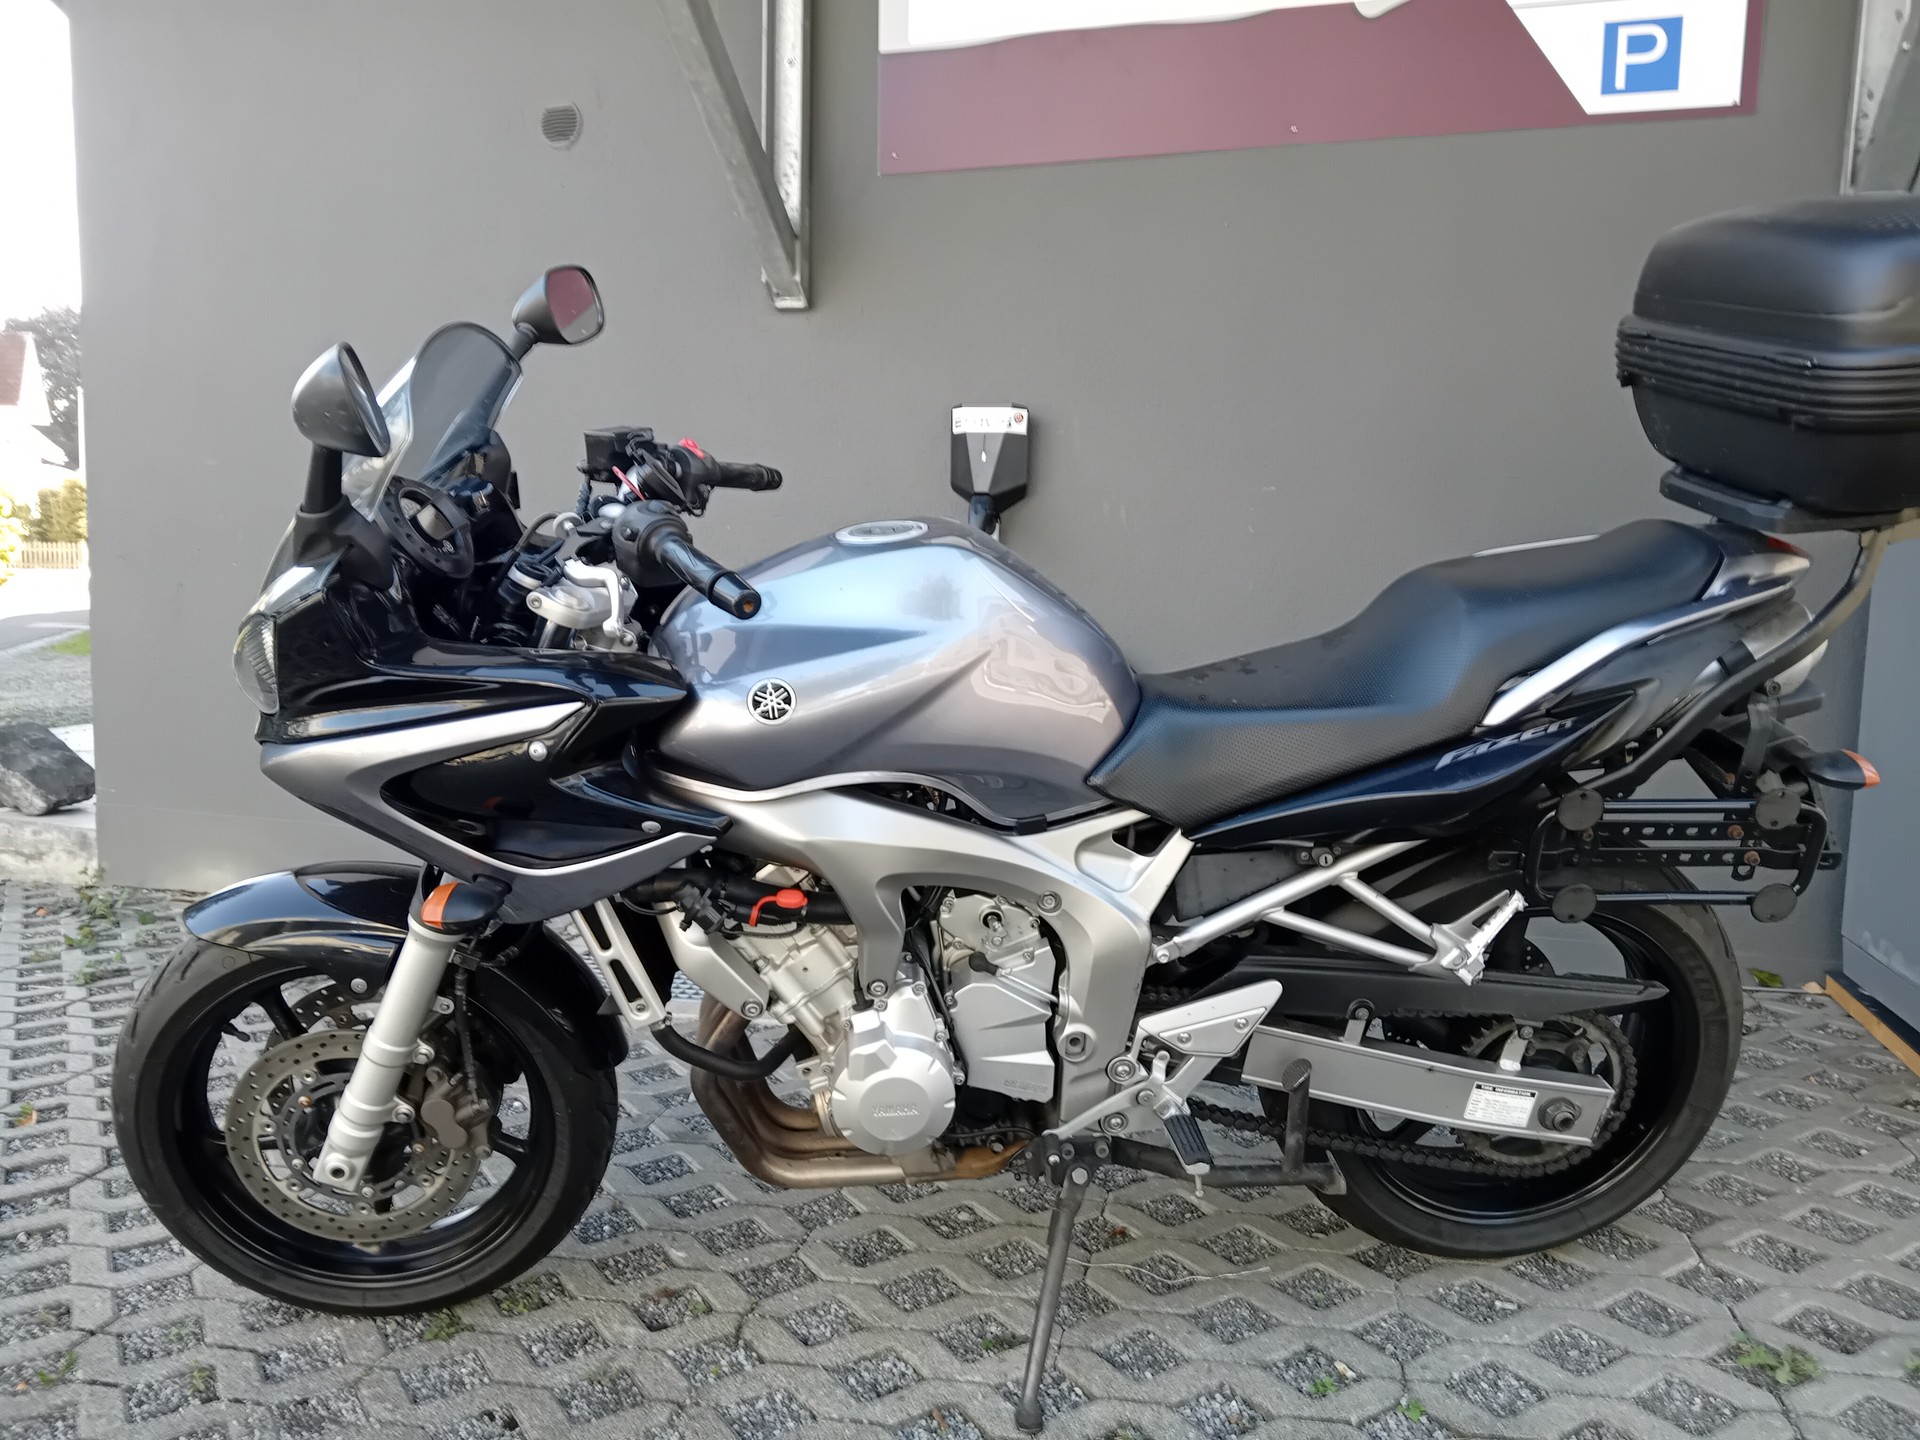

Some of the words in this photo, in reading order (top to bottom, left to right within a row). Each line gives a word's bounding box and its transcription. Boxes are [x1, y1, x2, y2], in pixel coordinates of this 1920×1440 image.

[1614, 23, 1668, 91] P
[1433, 716, 1577, 771] FAZER
[872, 1103, 919, 1117] YAMAHA
